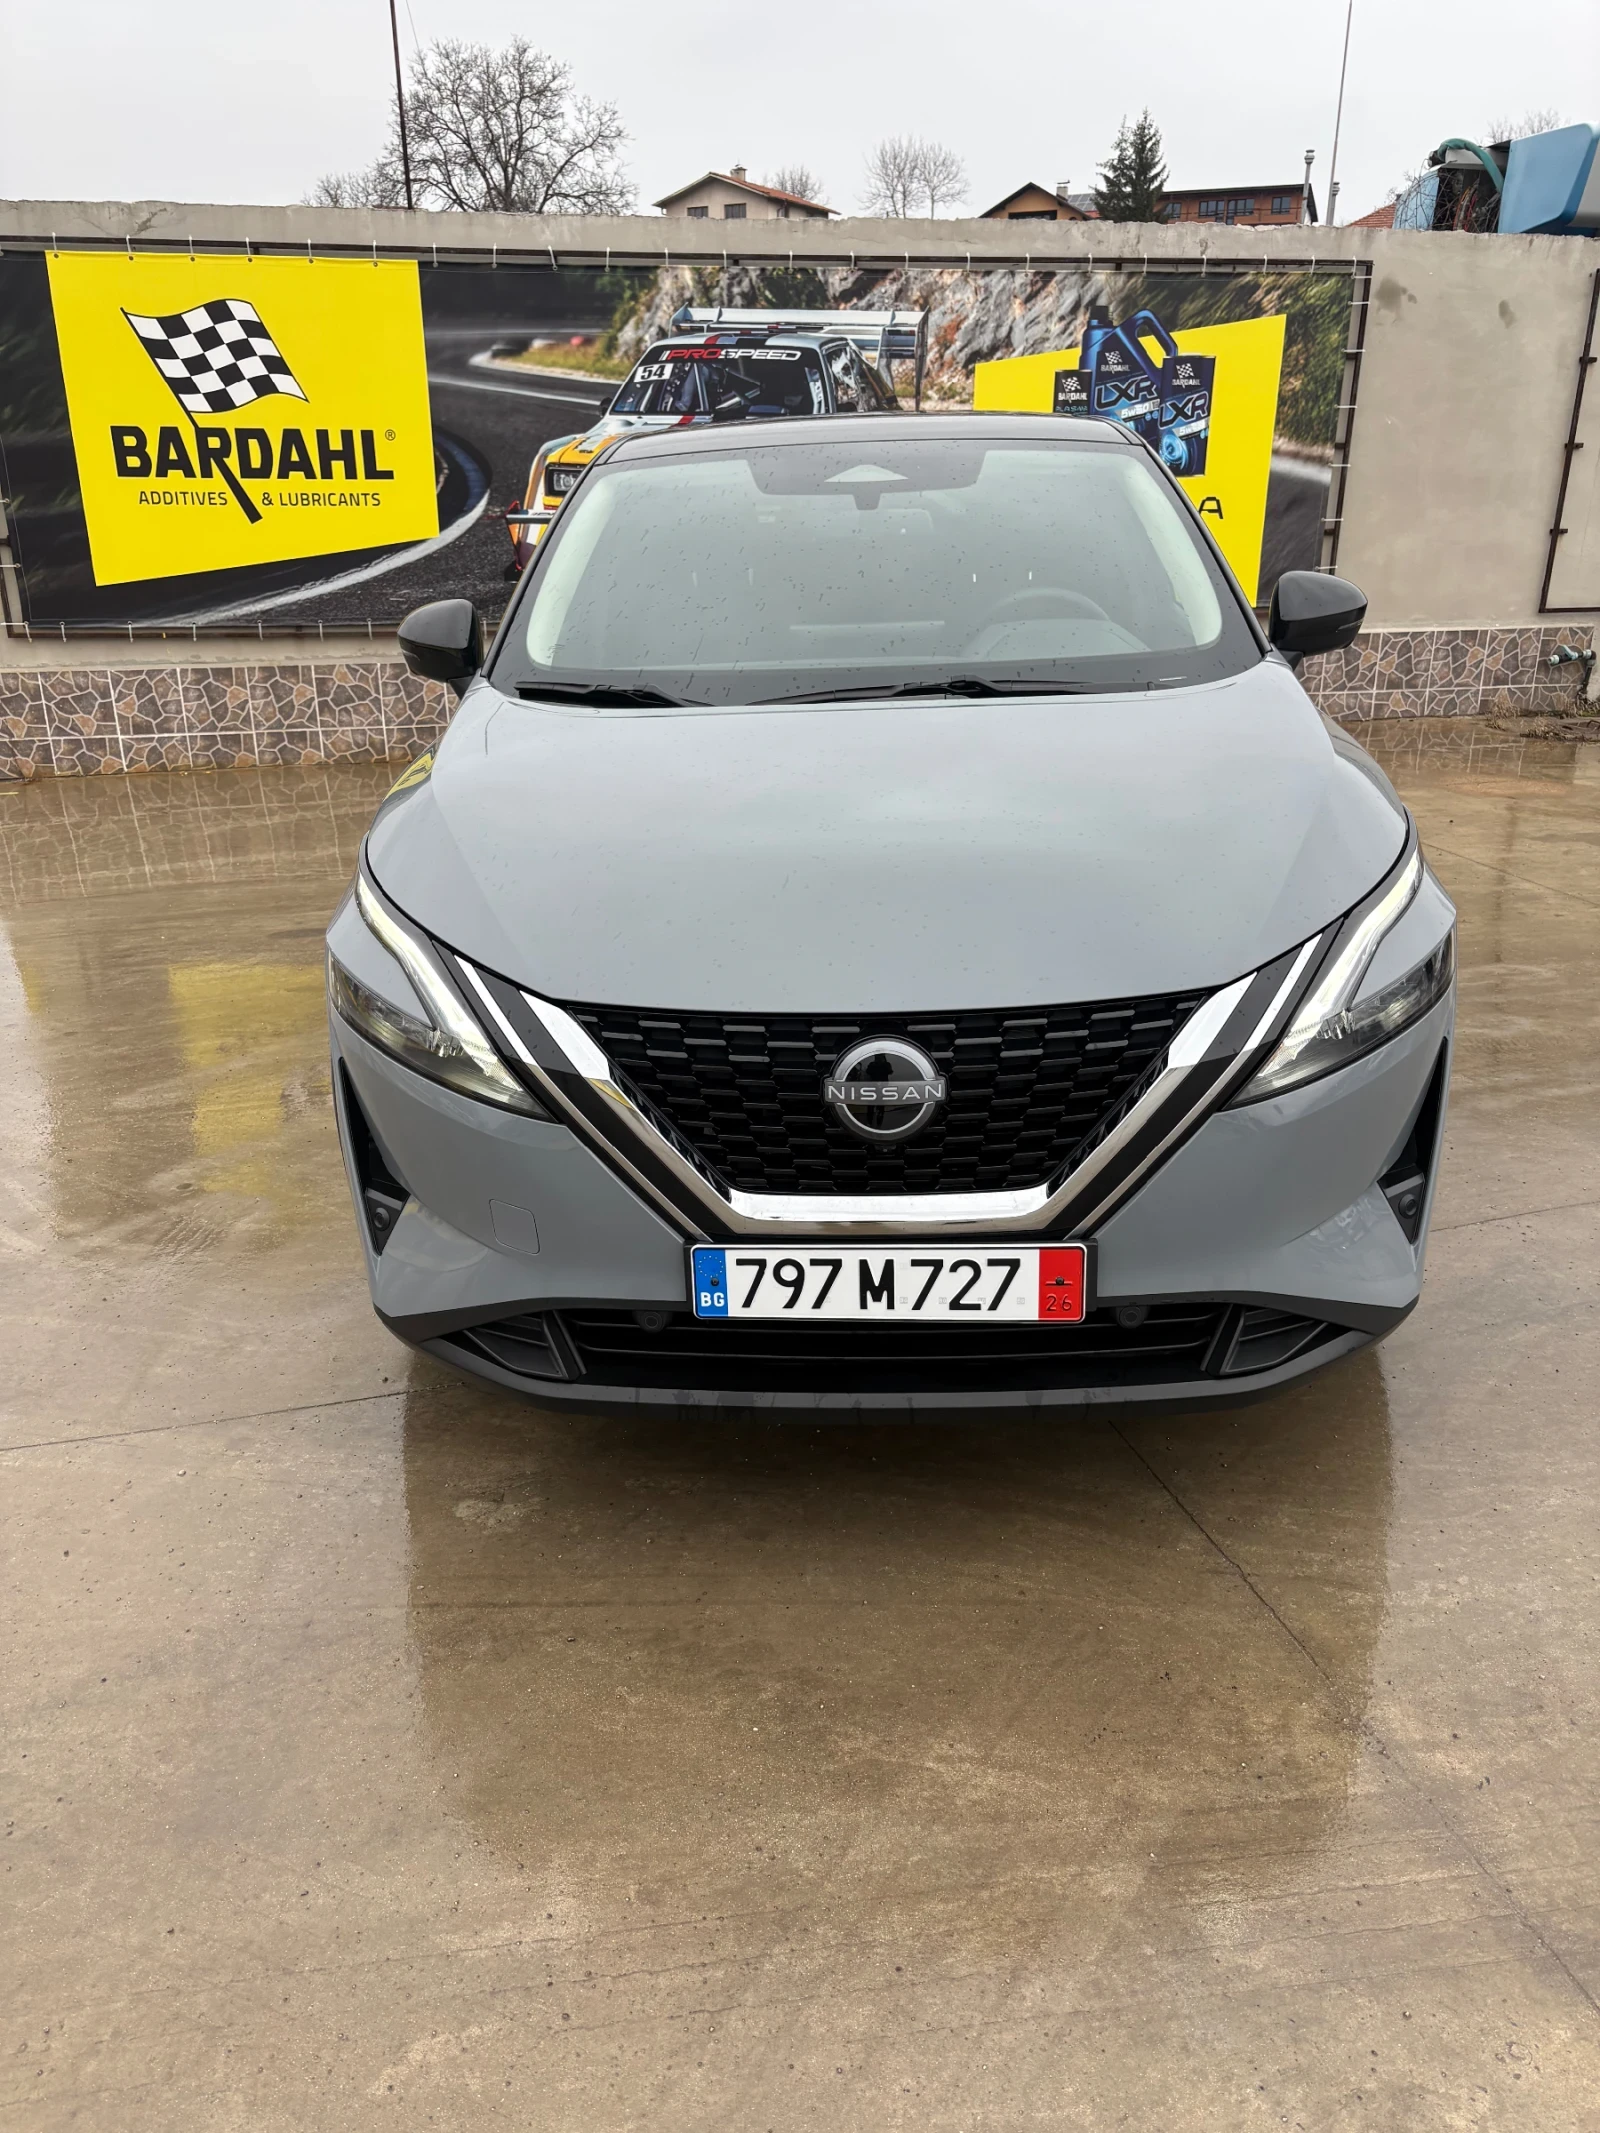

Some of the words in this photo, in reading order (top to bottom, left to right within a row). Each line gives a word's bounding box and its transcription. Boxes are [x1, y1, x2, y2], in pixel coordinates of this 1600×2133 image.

[640, 364, 666, 380] 54
[1095, 374, 1159, 411] LXR
[1158, 391, 1209, 430] LXR
[139, 491, 228, 506] ADDITIVES
[261, 492, 274, 506] &
[279, 492, 381, 507] LUBRICANTS
[828, 1083, 942, 1100] NISSAN
[735, 1258, 843, 1310] 797
[858, 1258, 895, 1311] M
[910, 1257, 1022, 1312] 727
[700, 1292, 726, 1308] BG
[1045, 1293, 1073, 1312] 26
